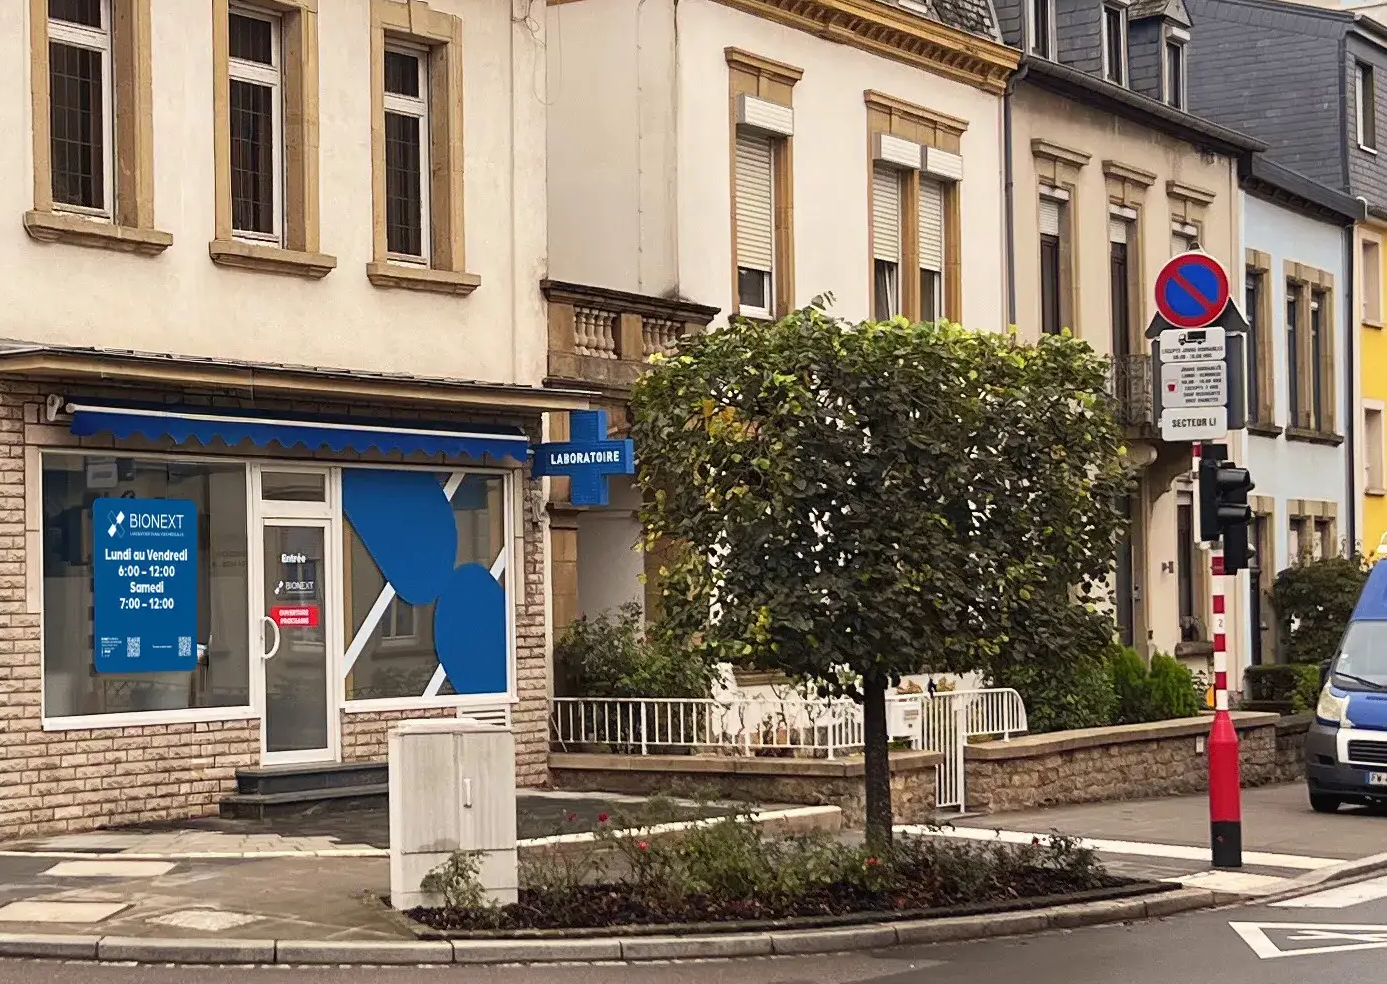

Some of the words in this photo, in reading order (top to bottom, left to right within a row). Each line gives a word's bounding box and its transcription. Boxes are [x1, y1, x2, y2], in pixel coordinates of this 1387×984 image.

[1209, 417, 1217, 426] LI
[550, 450, 620, 465] LABORATOIRE
[129, 513, 184, 529] BIONEXT
[105, 548, 131, 561] Lundi
[133, 551, 145, 561] au
[146, 548, 188, 561] Vendredi
[118, 565, 140, 577] 6:00
[149, 565, 175, 577] 12:00
[130, 580, 164, 593] Samedi
[285, 581, 314, 590] BIONEXT
[119, 597, 140, 609] 7:00
[149, 597, 175, 609] 12:00
